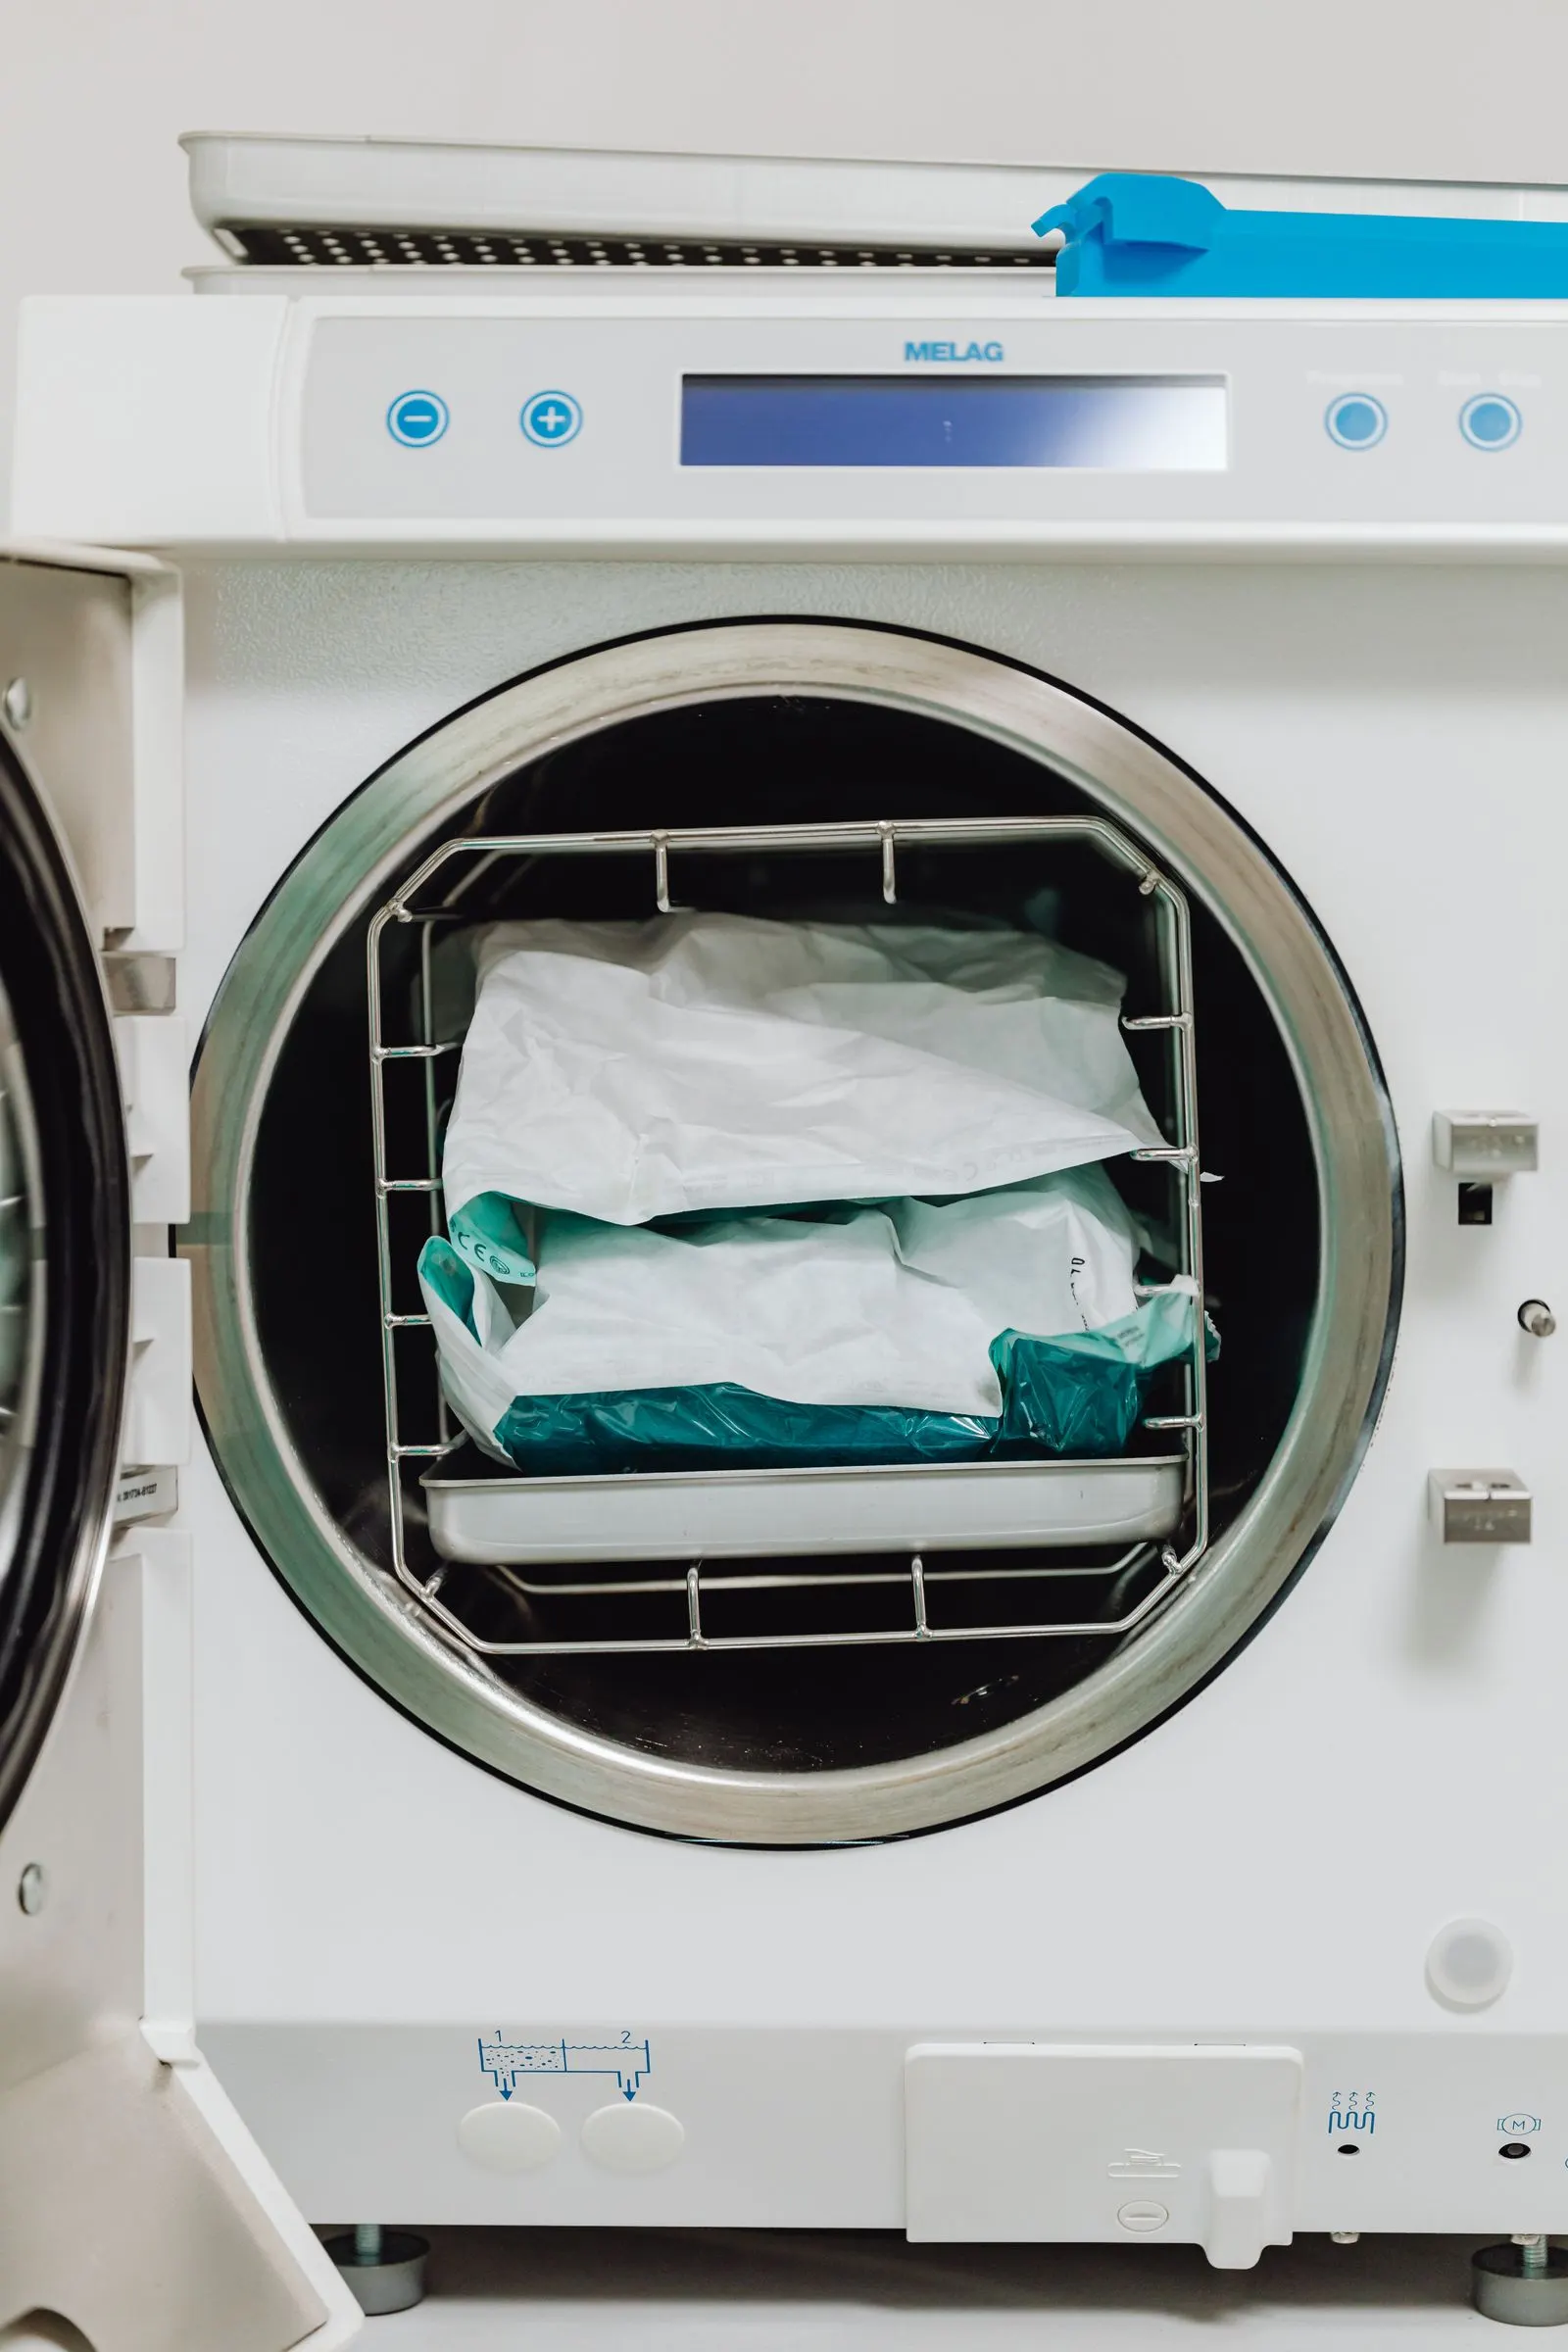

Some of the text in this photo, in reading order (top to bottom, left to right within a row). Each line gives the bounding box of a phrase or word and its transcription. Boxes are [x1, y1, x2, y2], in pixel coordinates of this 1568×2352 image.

[904, 341, 1004, 362] MELAG
[494, 2030, 503, 2042] 1
[620, 2030, 632, 2043] 2
[1512, 2120, 1526, 2131] M
